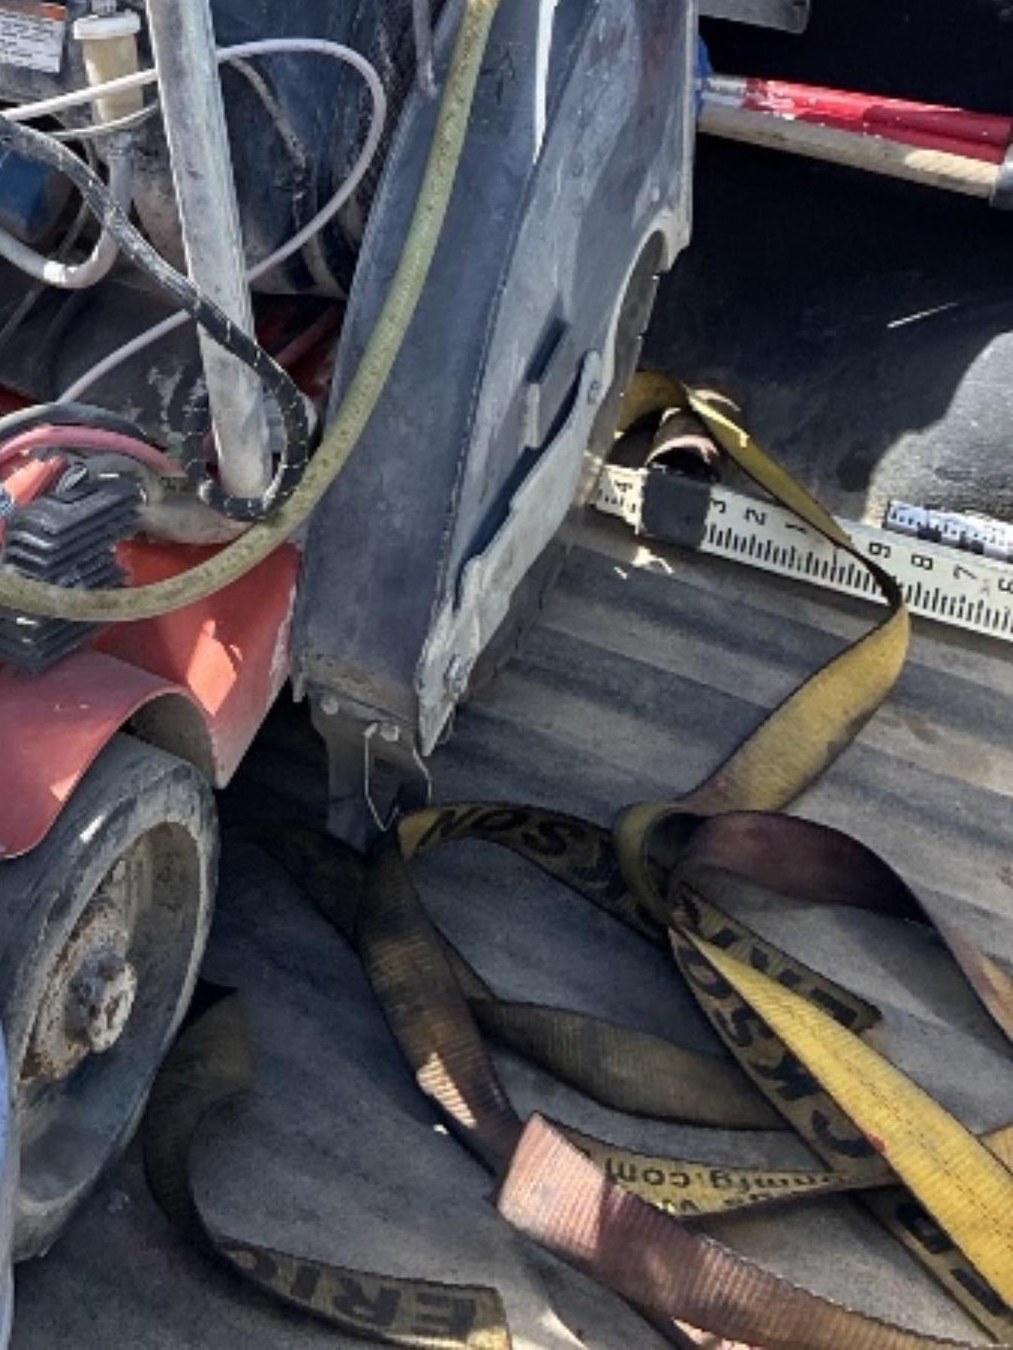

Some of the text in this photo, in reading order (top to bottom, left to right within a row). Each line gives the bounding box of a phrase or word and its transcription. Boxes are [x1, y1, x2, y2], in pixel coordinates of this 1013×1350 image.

[868, 541, 891, 559] 9
[911, 554, 933, 571] 8
[953, 564, 977, 579] 7
